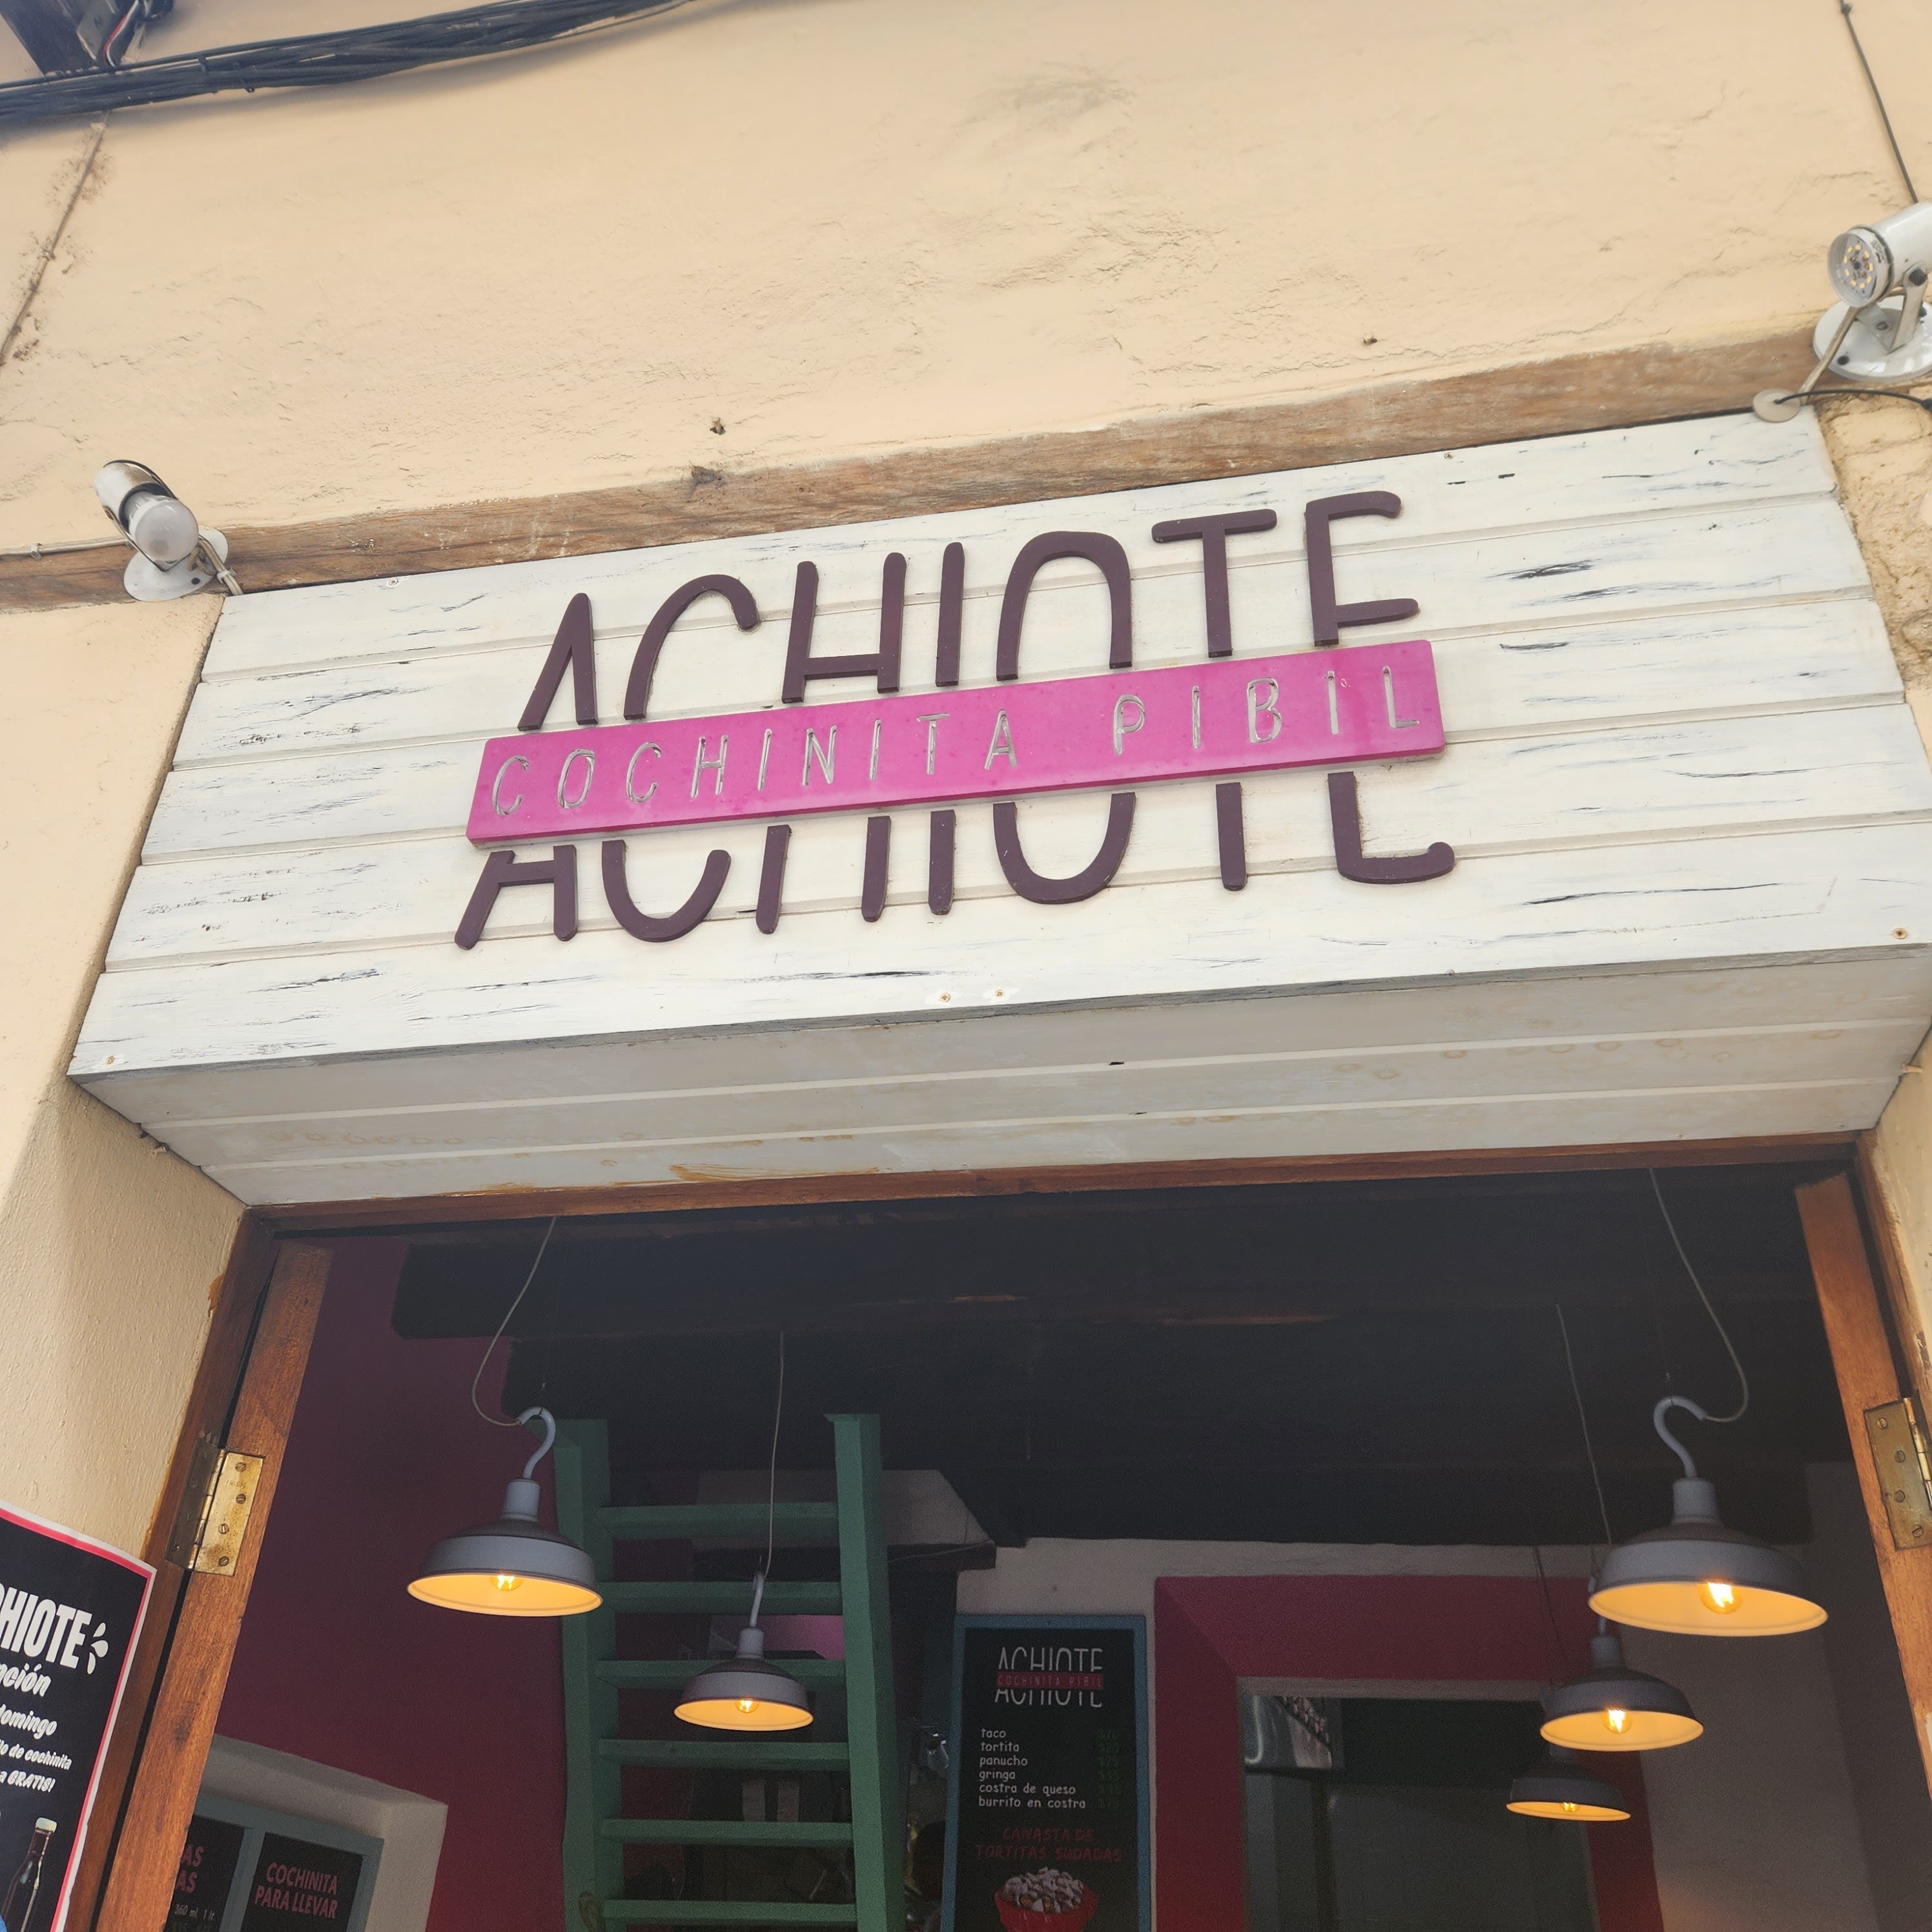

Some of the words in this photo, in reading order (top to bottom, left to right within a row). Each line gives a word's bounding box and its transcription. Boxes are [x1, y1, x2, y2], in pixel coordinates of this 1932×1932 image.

[454, 489, 1456, 951] ACHIOTE
[491, 708, 1017, 816] COCHINITA
[1112, 665, 1421, 757] PIBIL
[981, 1727, 1007, 1738] taco
[981, 1741, 1020, 1752] tortita
[8, 1743, 25, 1759] de
[25, 1747, 72, 1770] cochinita
[980, 1754, 1028, 1768] panucho
[7, 1770, 56, 1793] GRATIS!
[979, 1768, 1016, 1782] gringa
[979, 1783, 1017, 1793] costra
[1023, 1782, 1036, 1794] de
[1042, 1785, 1076, 1797] queso
[978, 1795, 1021, 1807] burrito
[1027, 1799, 1042, 1808] en
[1047, 1798, 1086, 1809] costra
[1002, 1827, 1071, 1842] CANASTA
[1074, 1828, 1094, 1843] DE
[976, 1844, 1047, 1860] TORTITAS
[266, 1862, 338, 1895] COCHINITA
[254, 1884, 290, 1911] PARA
[291, 1892, 338, 1920] LLEVAR
